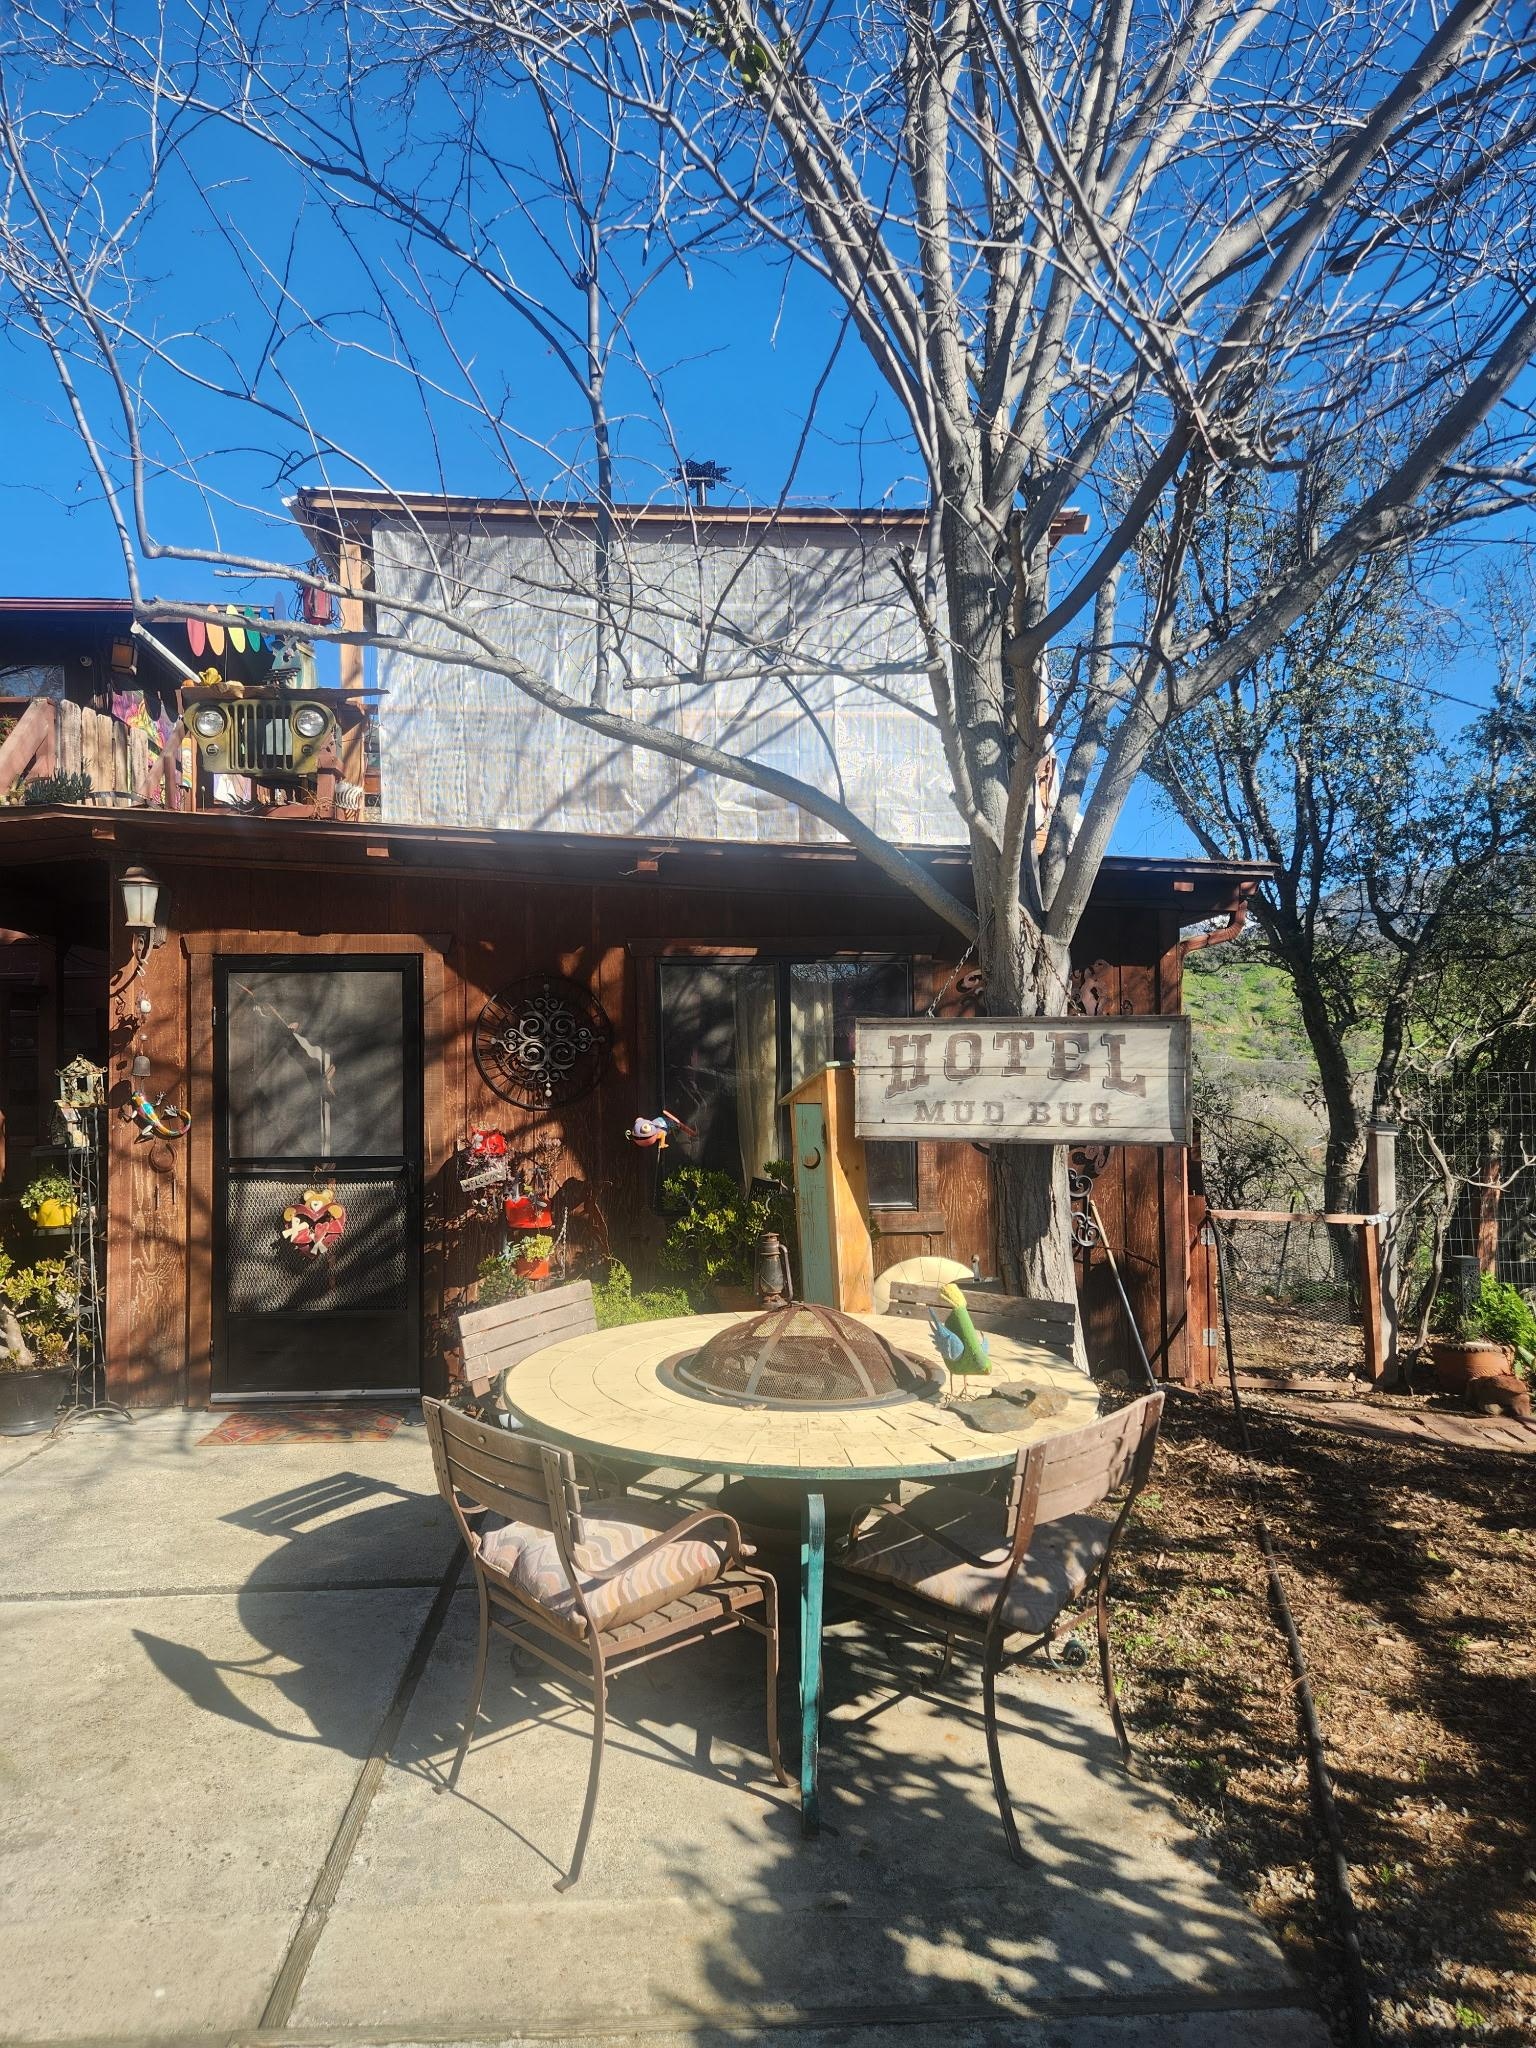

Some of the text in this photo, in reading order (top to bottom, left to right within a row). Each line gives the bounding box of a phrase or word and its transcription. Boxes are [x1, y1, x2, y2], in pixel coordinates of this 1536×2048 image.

[885, 1031, 1147, 1099] HOTEL
[913, 1099, 1113, 1128] MUD BUG
